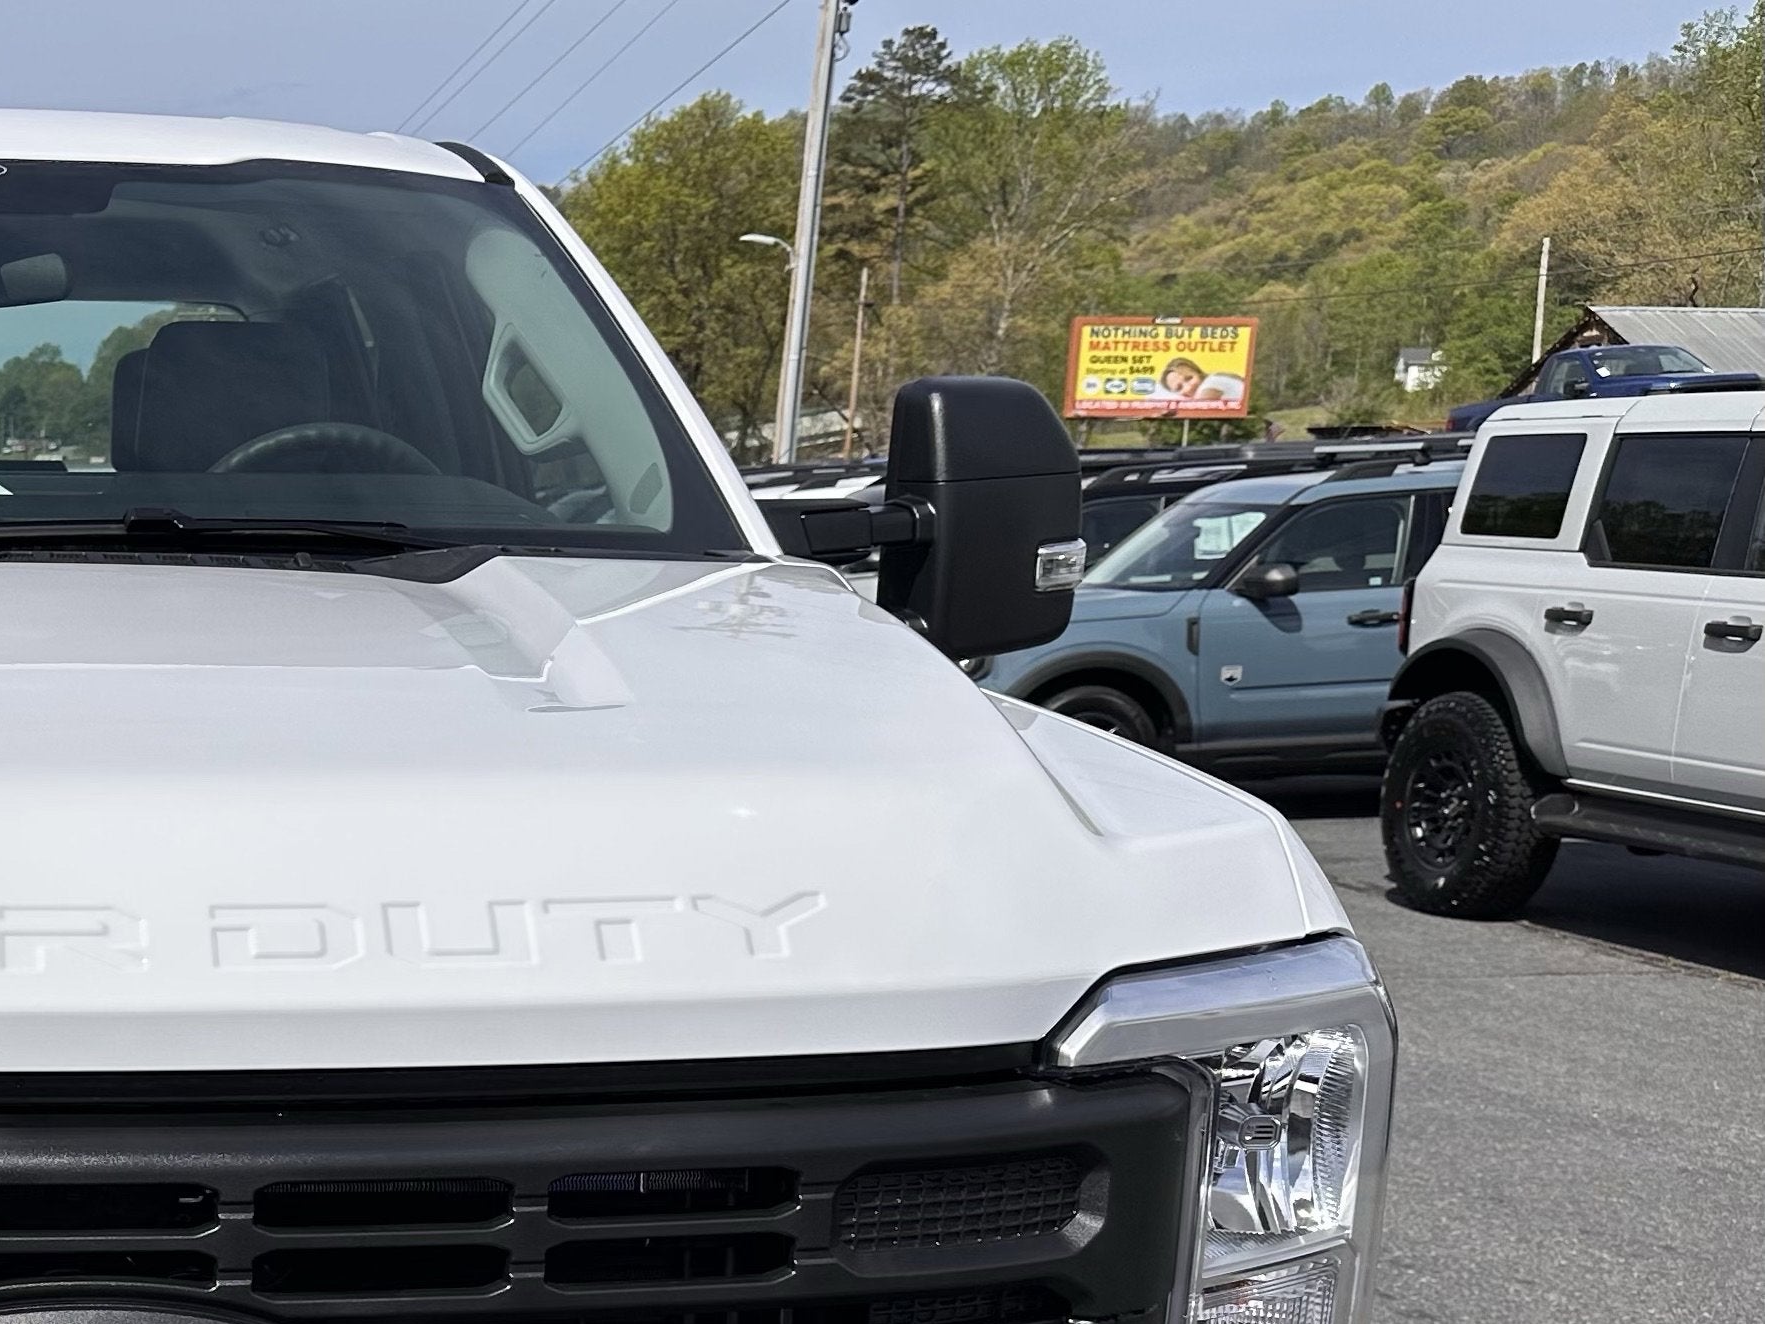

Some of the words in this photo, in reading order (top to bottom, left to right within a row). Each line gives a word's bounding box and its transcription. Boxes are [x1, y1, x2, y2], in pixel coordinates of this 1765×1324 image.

[1090, 327, 1159, 339] NOTHING
[1164, 327, 1194, 339] BUT
[1200, 327, 1239, 340] BEDS
[1089, 341, 1170, 353] MATTRESS
[1176, 341, 1237, 353] OUTLET
[1089, 355, 1128, 364] QUEEN
[1132, 355, 1152, 364] SET
[209, 889, 828, 972] DUTY
